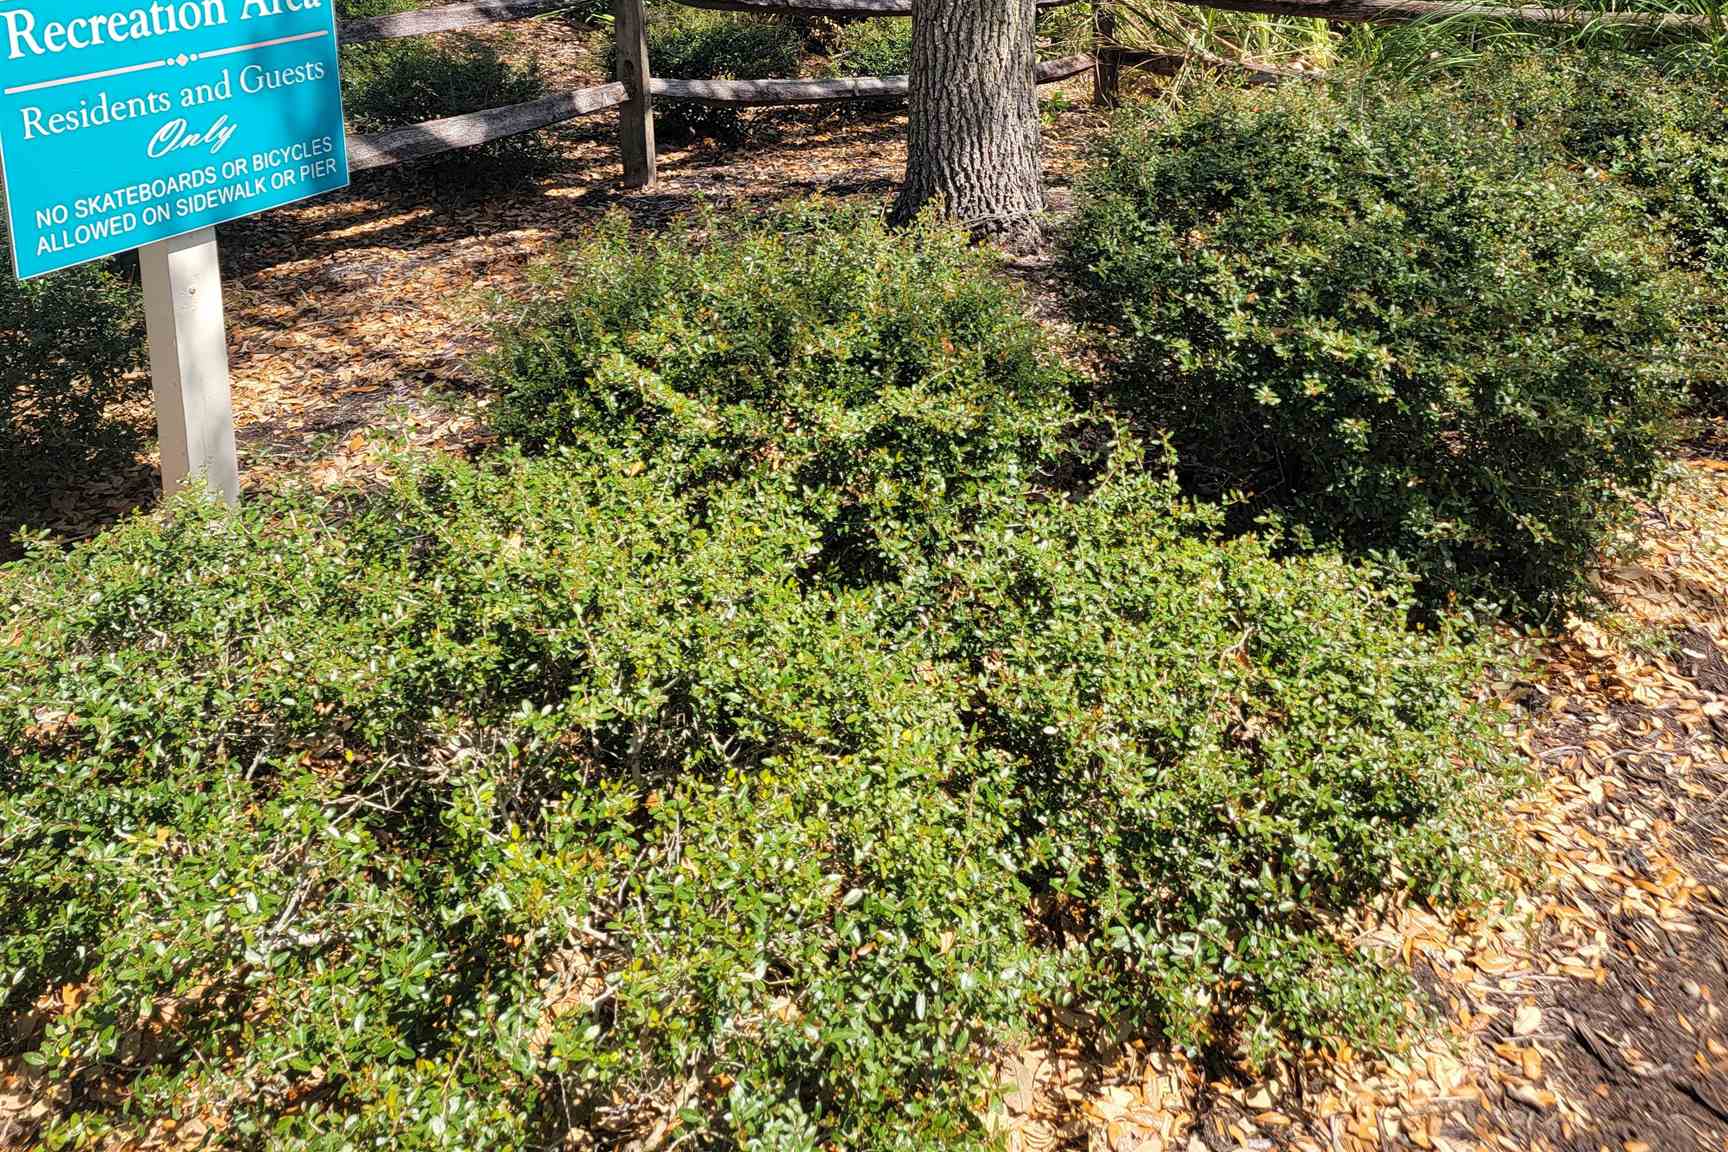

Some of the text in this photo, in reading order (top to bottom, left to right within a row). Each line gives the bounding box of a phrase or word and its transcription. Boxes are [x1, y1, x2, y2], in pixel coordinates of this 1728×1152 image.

[20, 60, 325, 139] Residents and Guests
[147, 115, 238, 159] Only
[36, 135, 333, 229] NO SKATEBOARDS OR BICYCLES
[36, 157, 337, 257] ALLOWED ON SIDEWALK OR PIER
